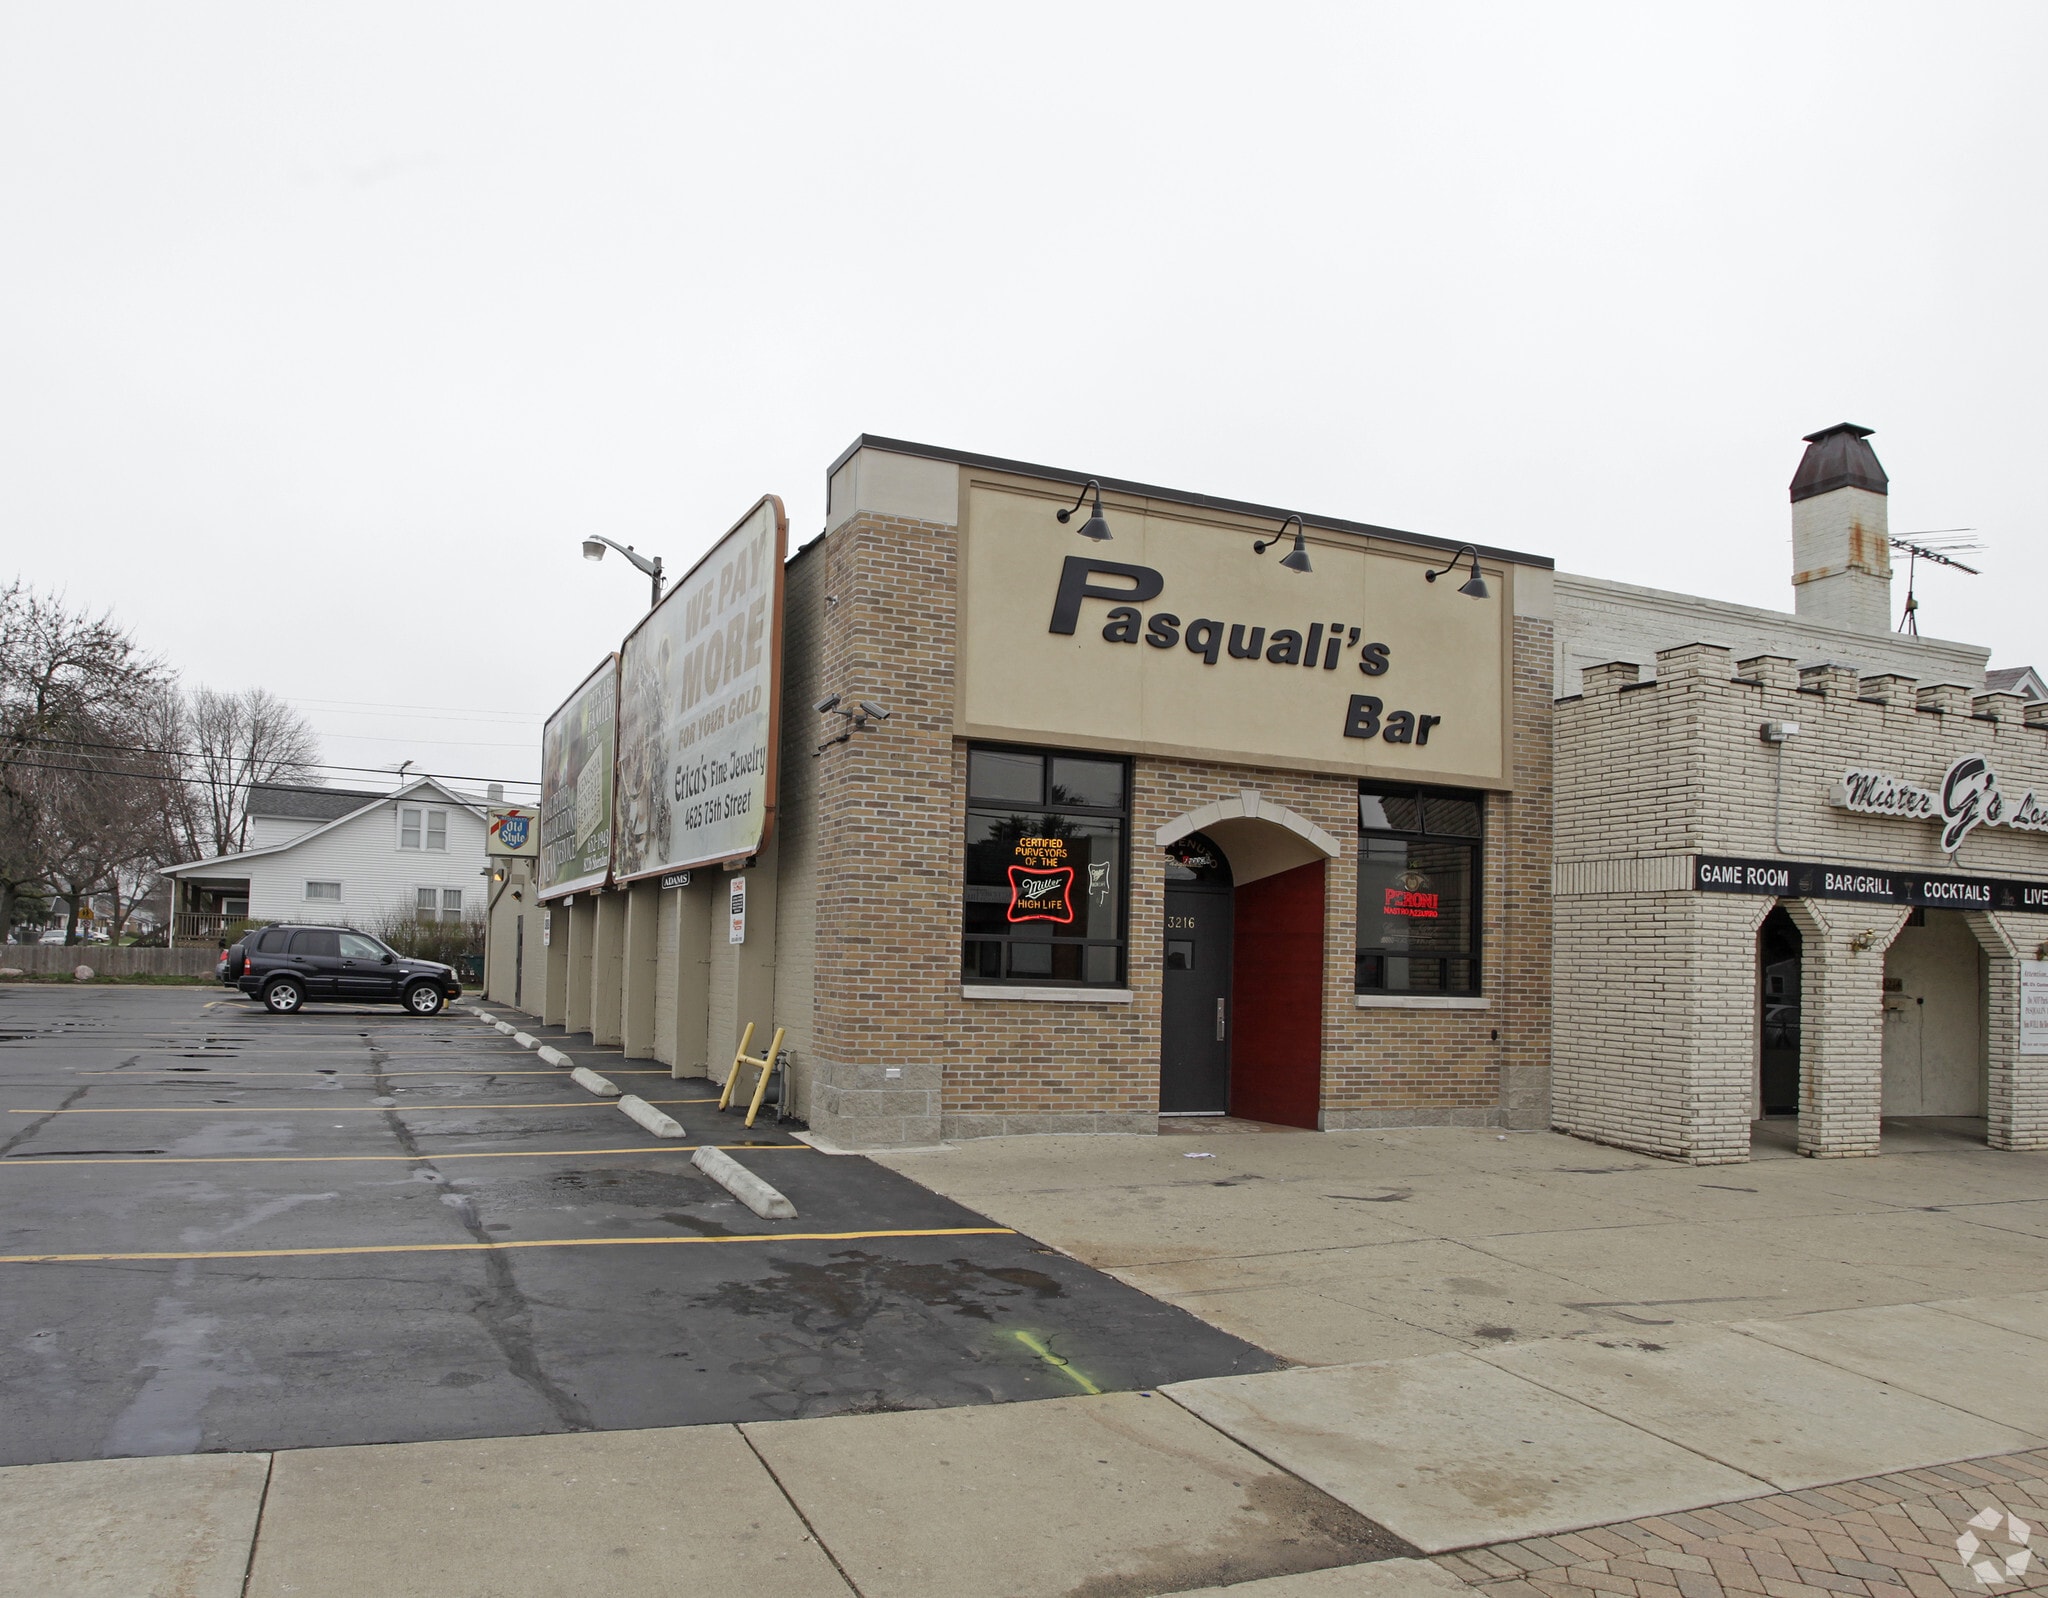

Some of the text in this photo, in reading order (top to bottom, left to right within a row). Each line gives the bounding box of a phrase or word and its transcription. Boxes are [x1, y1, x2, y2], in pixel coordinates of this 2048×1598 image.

[686, 528, 766, 643] WE PAY
[1048, 555, 1391, 676] Pasquali's
[681, 593, 766, 714] MORE
[678, 685, 762, 751] FOR YOUR GOLD
[1342, 694, 1441, 745] Bar
[674, 742, 766, 802] Erica's Fine Jewelry
[1846, 772, 1933, 813] Mister
[685, 788, 751, 831] 4625 75th Street
[506, 821, 523, 832] Old
[501, 830, 526, 846] Style
[1020, 838, 1063, 848] CERTIFIED
[1015, 847, 1067, 858] PURVEYORS
[1025, 857, 1058, 867] OF THE
[664, 873, 688, 887] ADAMS
[1700, 864, 1788, 887] GAME ROOM
[1825, 873, 1893, 895] BAR/GRILL
[1022, 879, 1062, 899] Miller
[1384, 888, 1439, 909] PERONI
[1924, 881, 1990, 902] COCKTAILS
[2024, 888, 2048, 906] LIVE
[1018, 900, 1062, 909] HIGH LIFE
[1167, 916, 1195, 929] 3216
